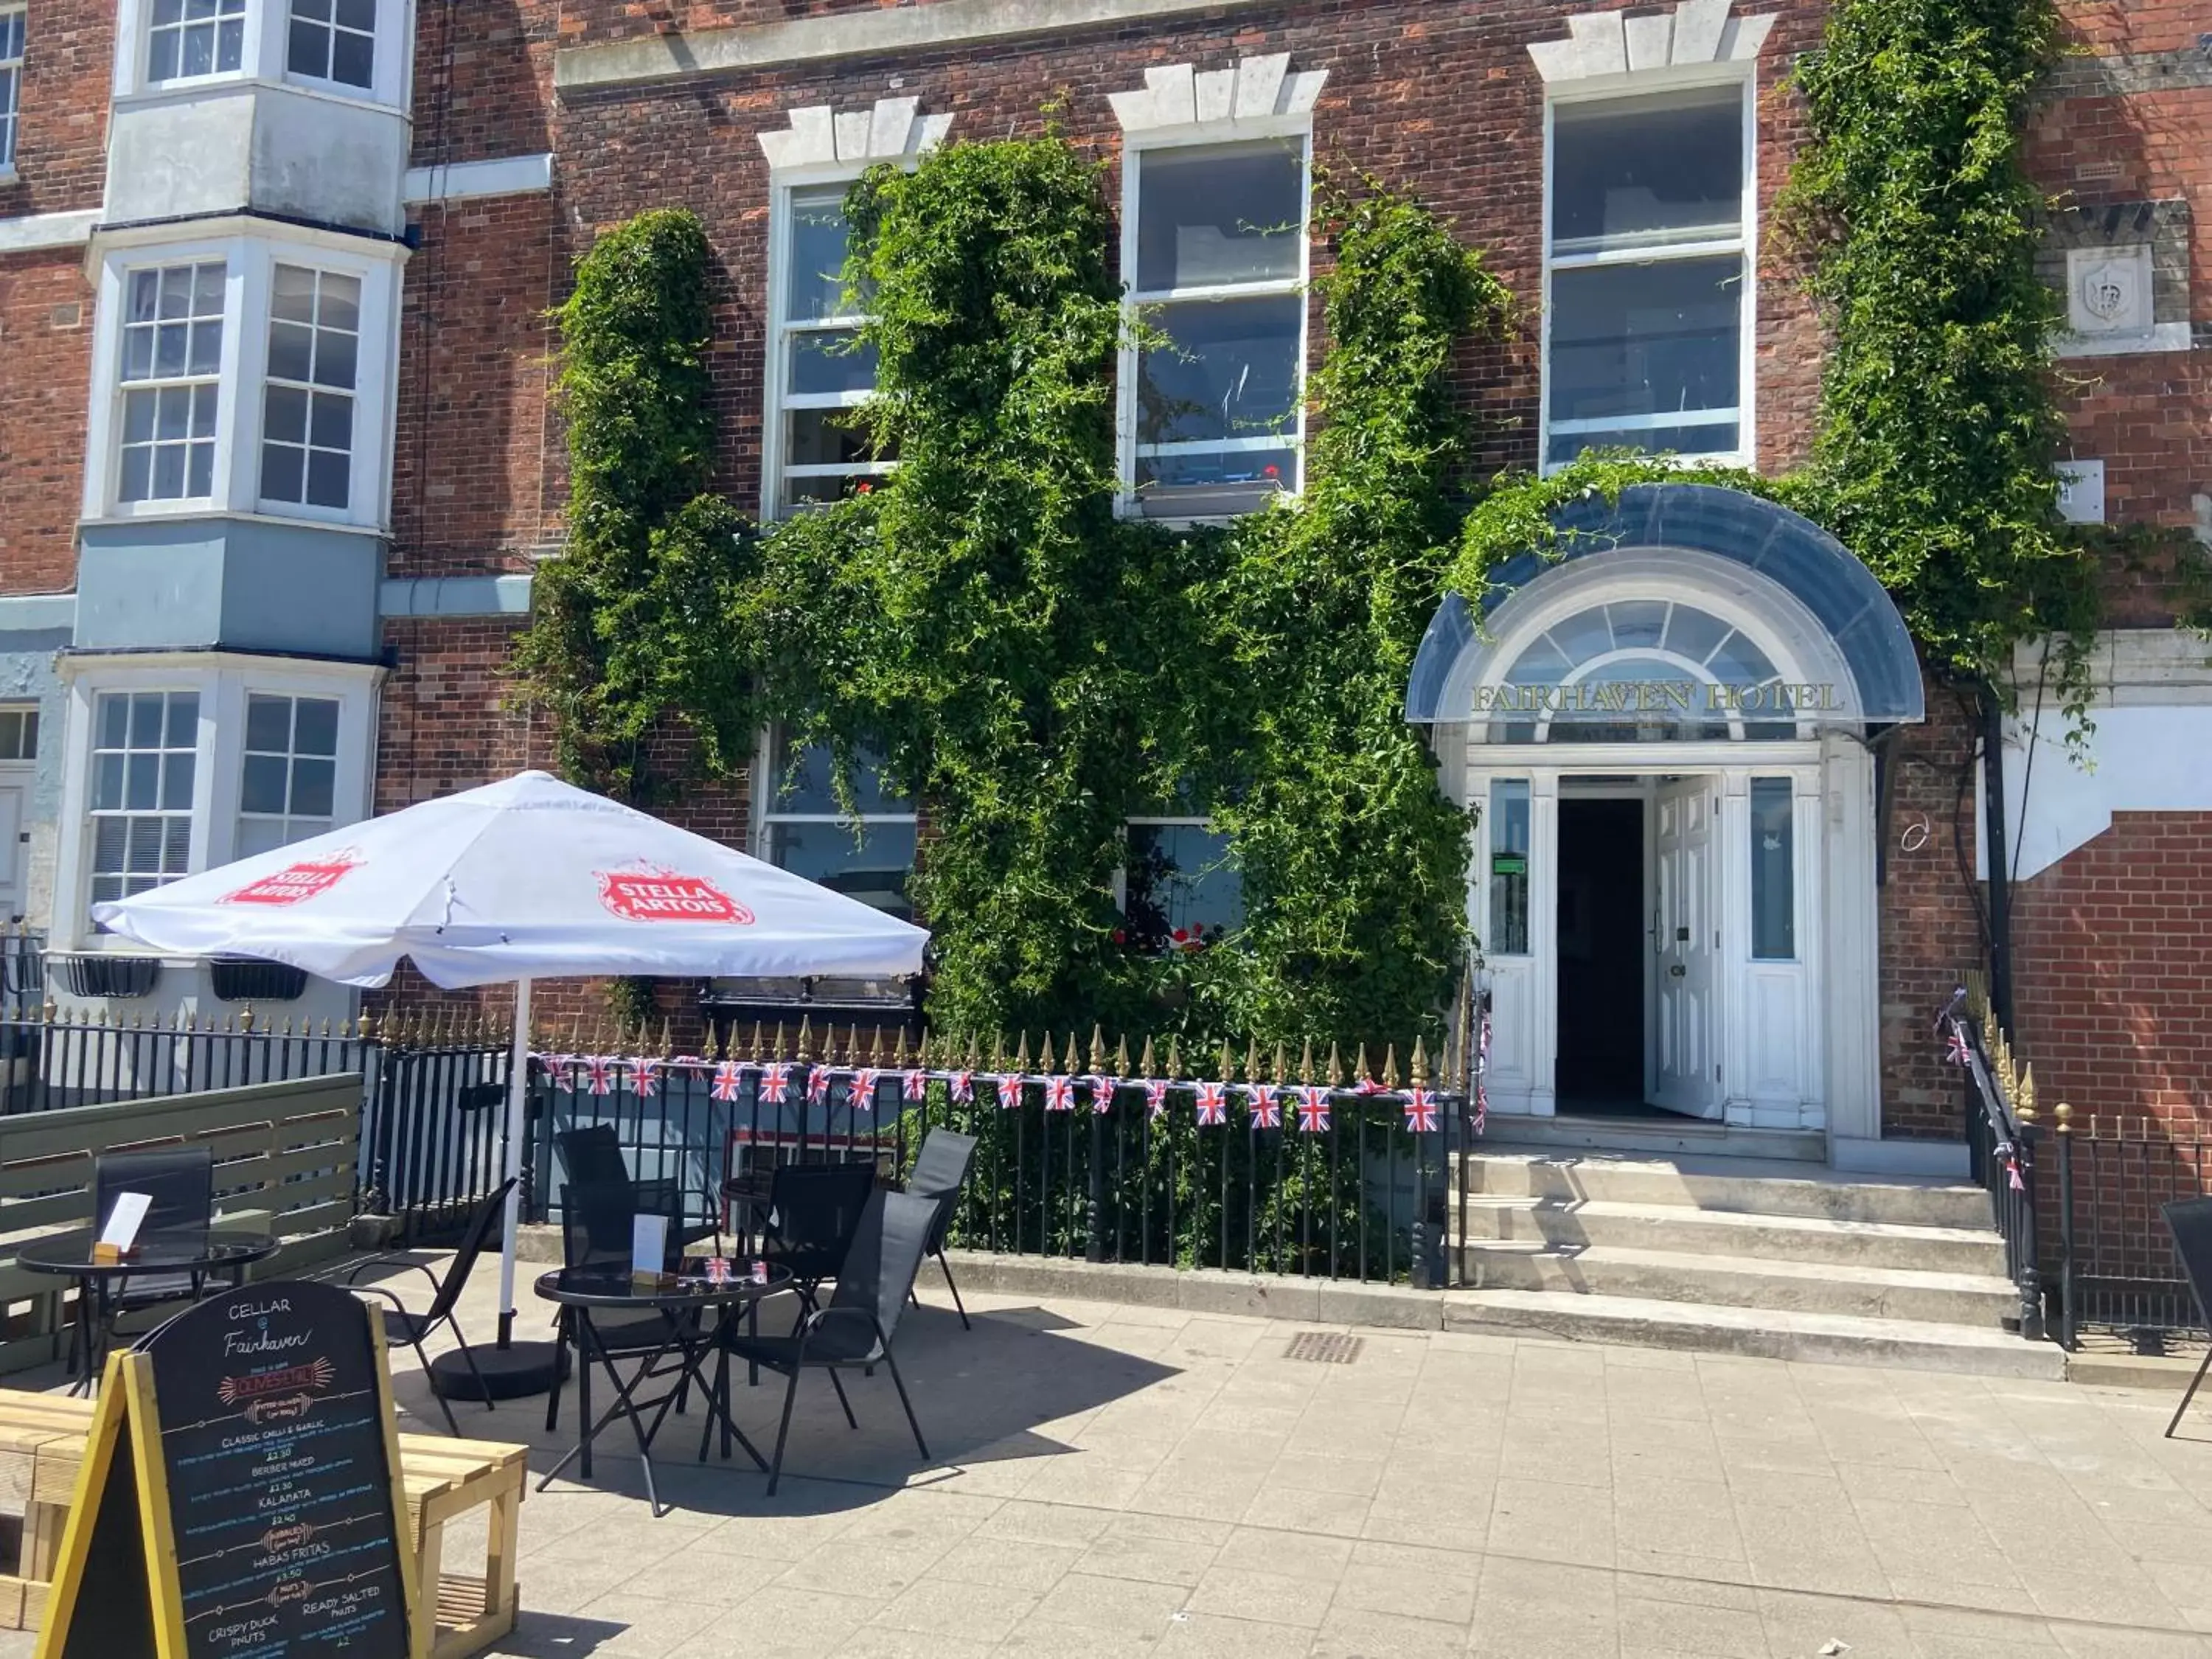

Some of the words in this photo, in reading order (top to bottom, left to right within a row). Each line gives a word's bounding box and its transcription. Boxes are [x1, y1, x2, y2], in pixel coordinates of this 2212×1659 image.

[1472, 683, 1694, 711] FAIRHAVEN
[1705, 684, 1846, 710] HOTEL
[276, 872, 337, 884] STELLA
[617, 883, 714, 900] STELLA
[631, 897, 726, 913] ARTOIS
[229, 1298, 292, 1320] CELLAR
[223, 1327, 313, 1357] Fairhaven
[222, 1432, 260, 1449] CLASSIC
[296, 1419, 324, 1432] GARLIC
[259, 1488, 311, 1509] KALAMATA
[253, 1552, 290, 1569] HABAS
[292, 1540, 331, 1560] FRITAS
[302, 1598, 339, 1616] READY
[341, 1586, 380, 1604] SALTED
[209, 1623, 248, 1643] CRISPY
[249, 1615, 279, 1631] DUCK
[231, 1630, 266, 1647] PNUTS
